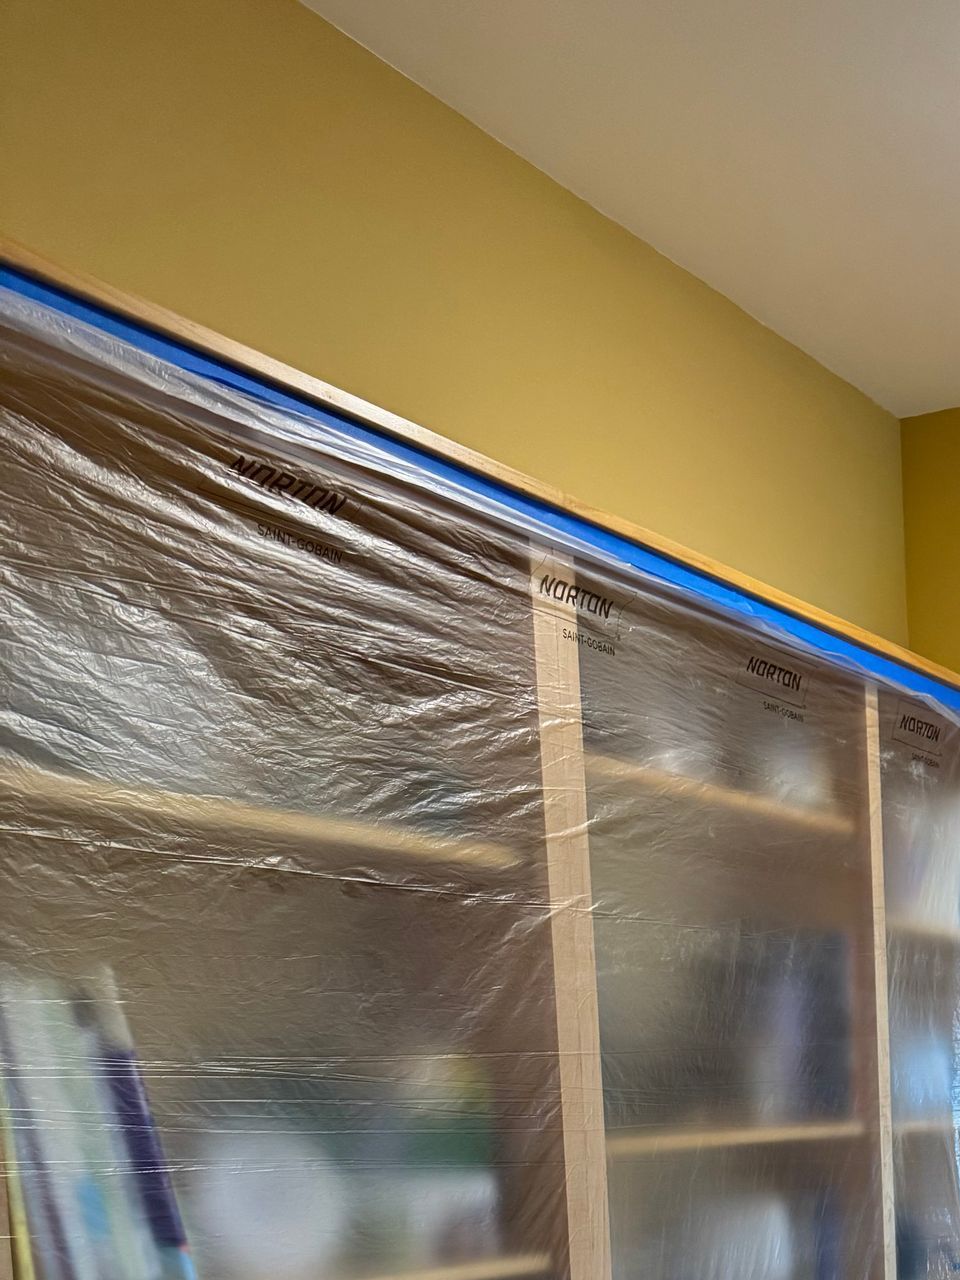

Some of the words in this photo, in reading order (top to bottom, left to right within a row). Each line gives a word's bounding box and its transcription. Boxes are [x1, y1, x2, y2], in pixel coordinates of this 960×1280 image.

[229, 455, 347, 515] NORTON
[257, 523, 343, 563] SAINT-GOBAIN
[540, 574, 614, 619] NORTON
[562, 628, 616, 657] SAINT-GOBAIN
[746, 656, 802, 691] NORTON
[900, 714, 941, 742] NORTON
